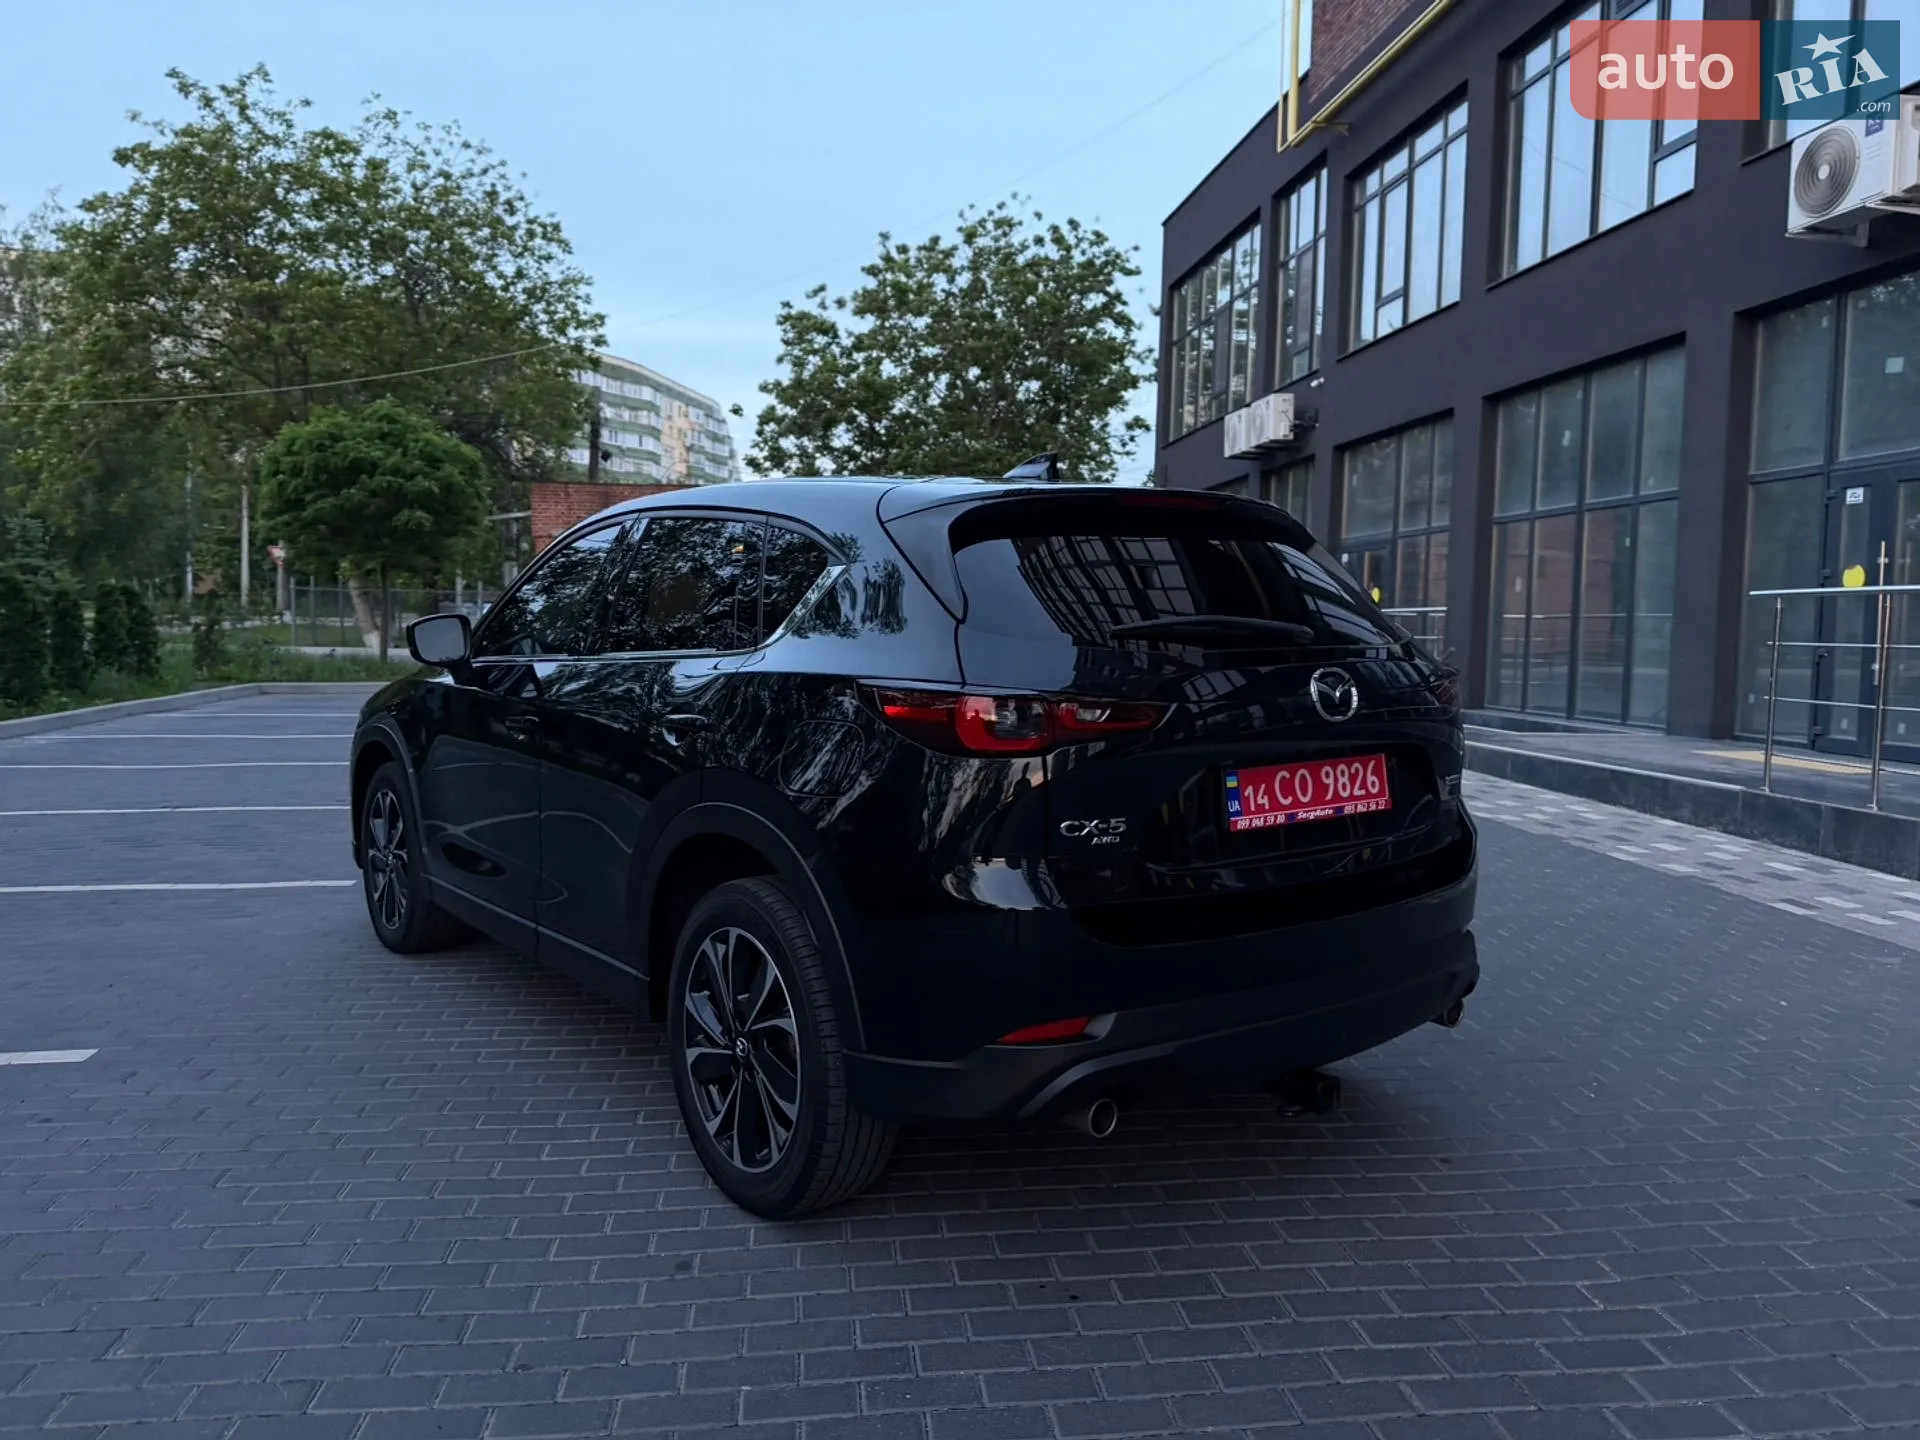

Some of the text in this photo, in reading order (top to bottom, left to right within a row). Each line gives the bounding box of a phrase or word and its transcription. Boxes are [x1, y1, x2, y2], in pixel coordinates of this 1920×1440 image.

[1244, 760, 1380, 811] 14 CO 9826
[1228, 800, 1241, 812] UA
[1297, 808, 1334, 820] SergAuto
[1060, 818, 1127, 837] CX-5
